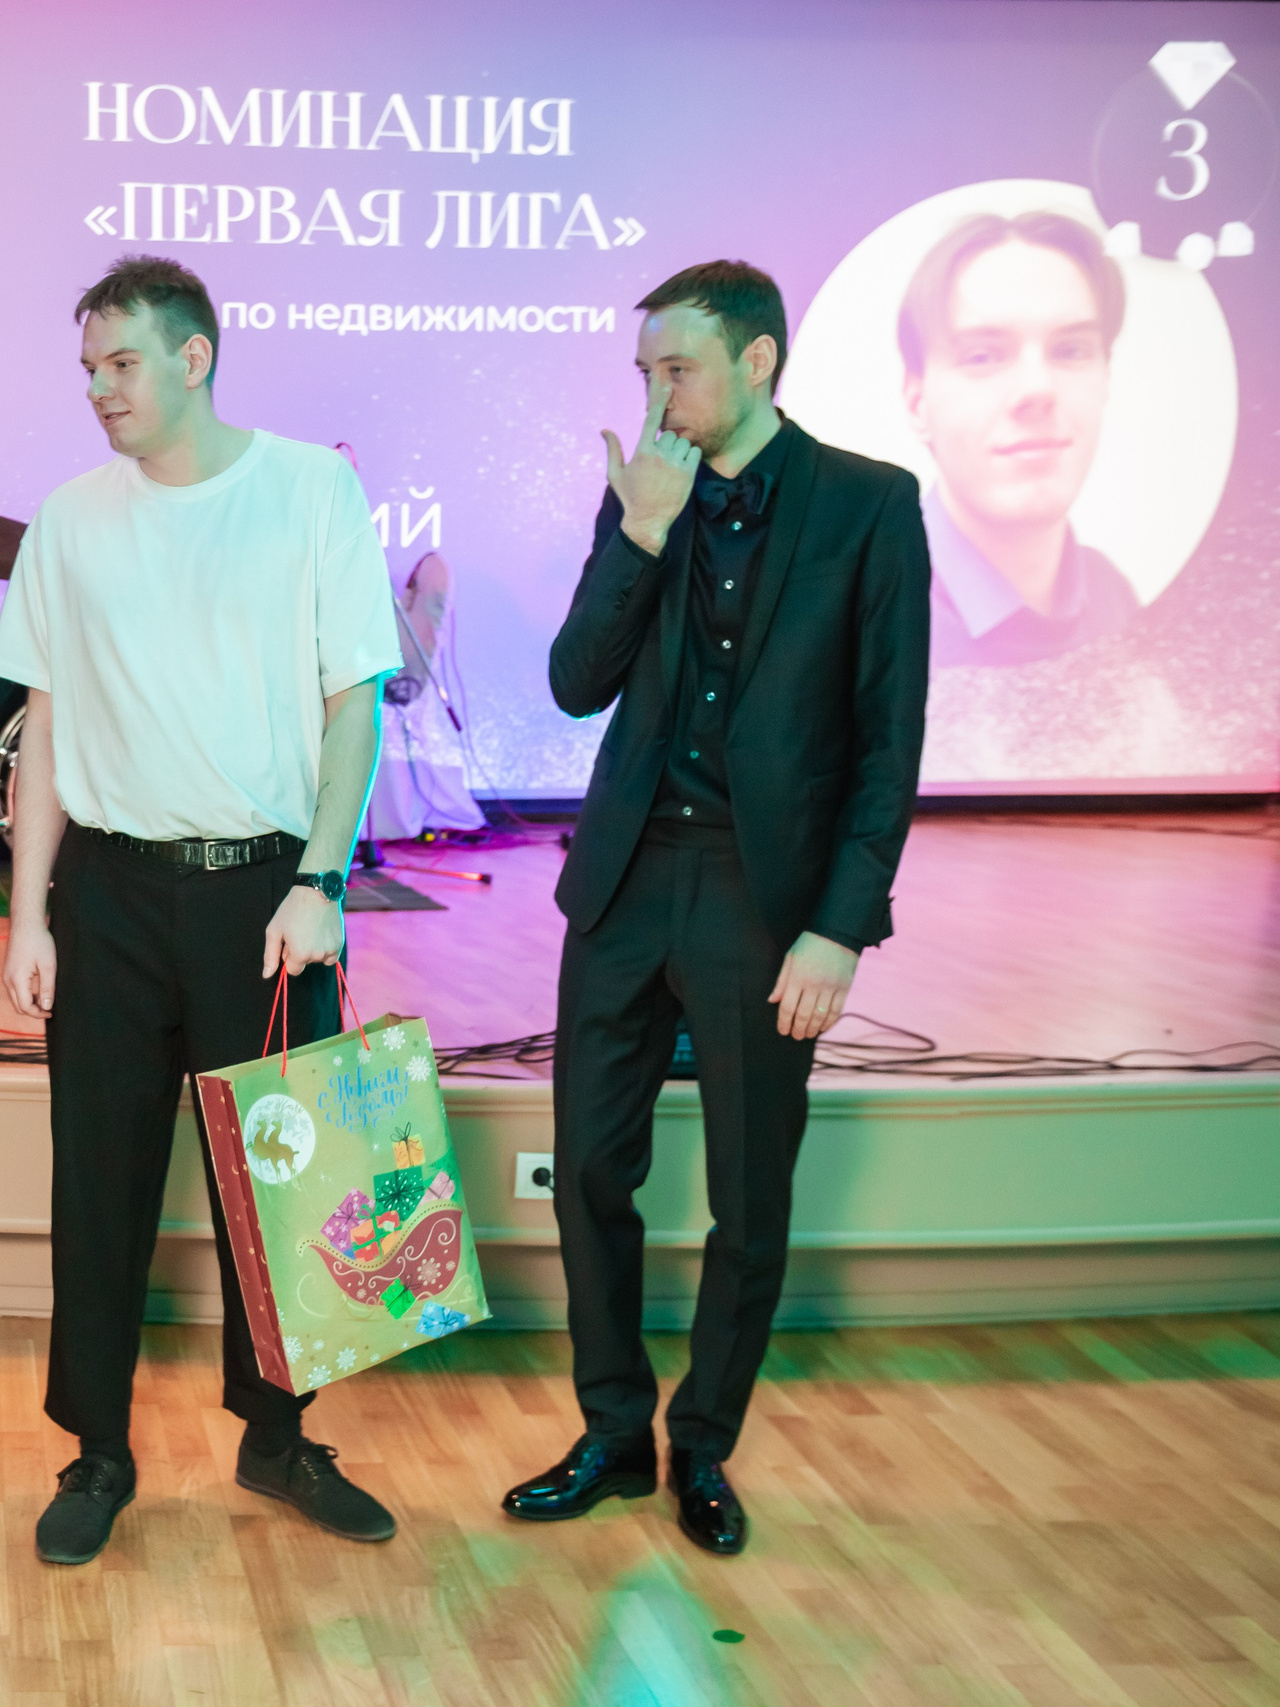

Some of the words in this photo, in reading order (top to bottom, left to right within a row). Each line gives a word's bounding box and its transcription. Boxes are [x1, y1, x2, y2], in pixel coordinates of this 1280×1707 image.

[81, 80, 578, 164] НОМИНАЦИЯ
[1155, 117, 1210, 201] 3
[82, 180, 407, 248] «ПЕРВАЯ
[424, 189, 648, 251] ЛИГА»
[221, 301, 277, 331] по
[286, 302, 616, 337] недвижимости
